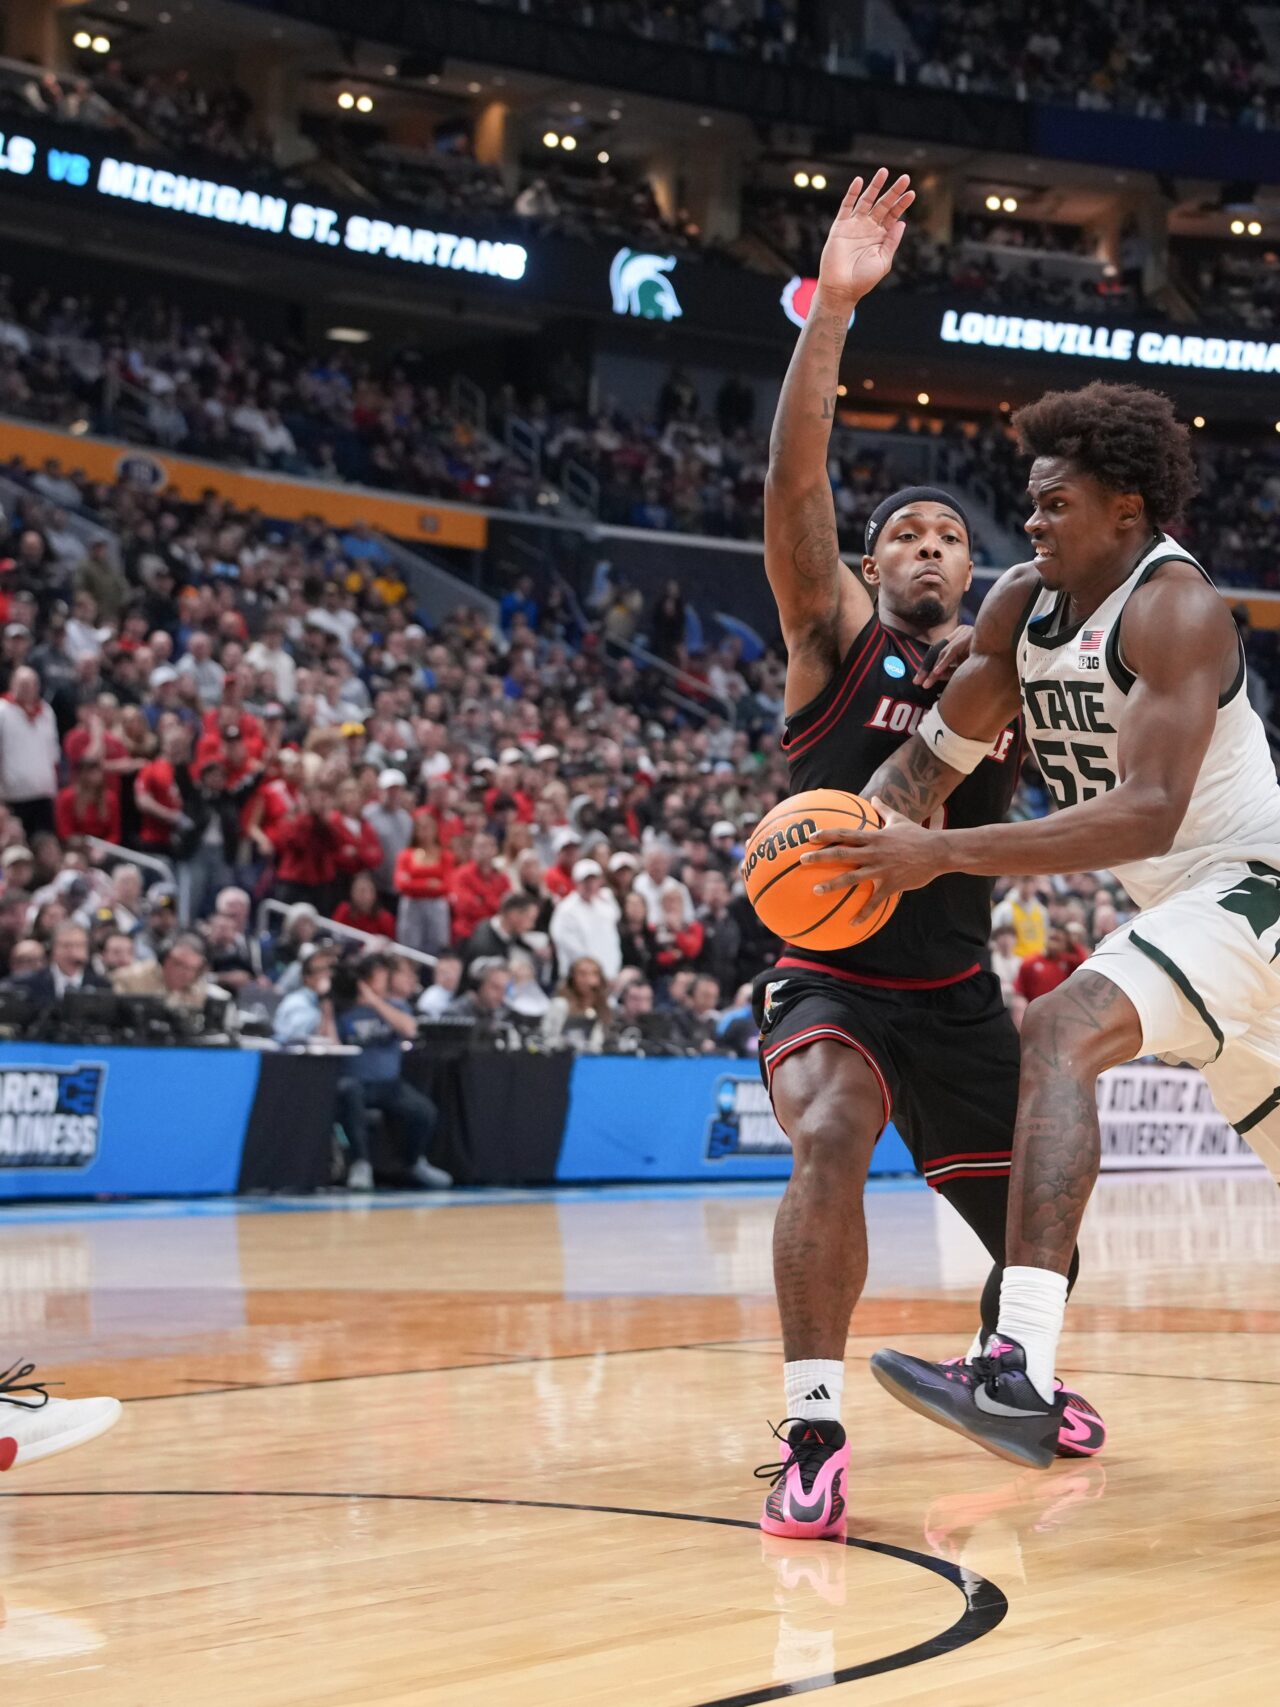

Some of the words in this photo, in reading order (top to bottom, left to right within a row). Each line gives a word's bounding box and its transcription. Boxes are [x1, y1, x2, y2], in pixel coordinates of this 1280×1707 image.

[47, 149, 91, 187] VS
[97, 157, 287, 233] MICHIGAN
[289, 203, 341, 246] ST.
[344, 215, 528, 280] SPARTANS
[940, 310, 1135, 360] LOUISVILLE
[1021, 678, 1118, 734] TATE
[1032, 738, 1117, 810] 55
[744, 818, 818, 882] Wilson
[0, 1071, 59, 1113] RCH
